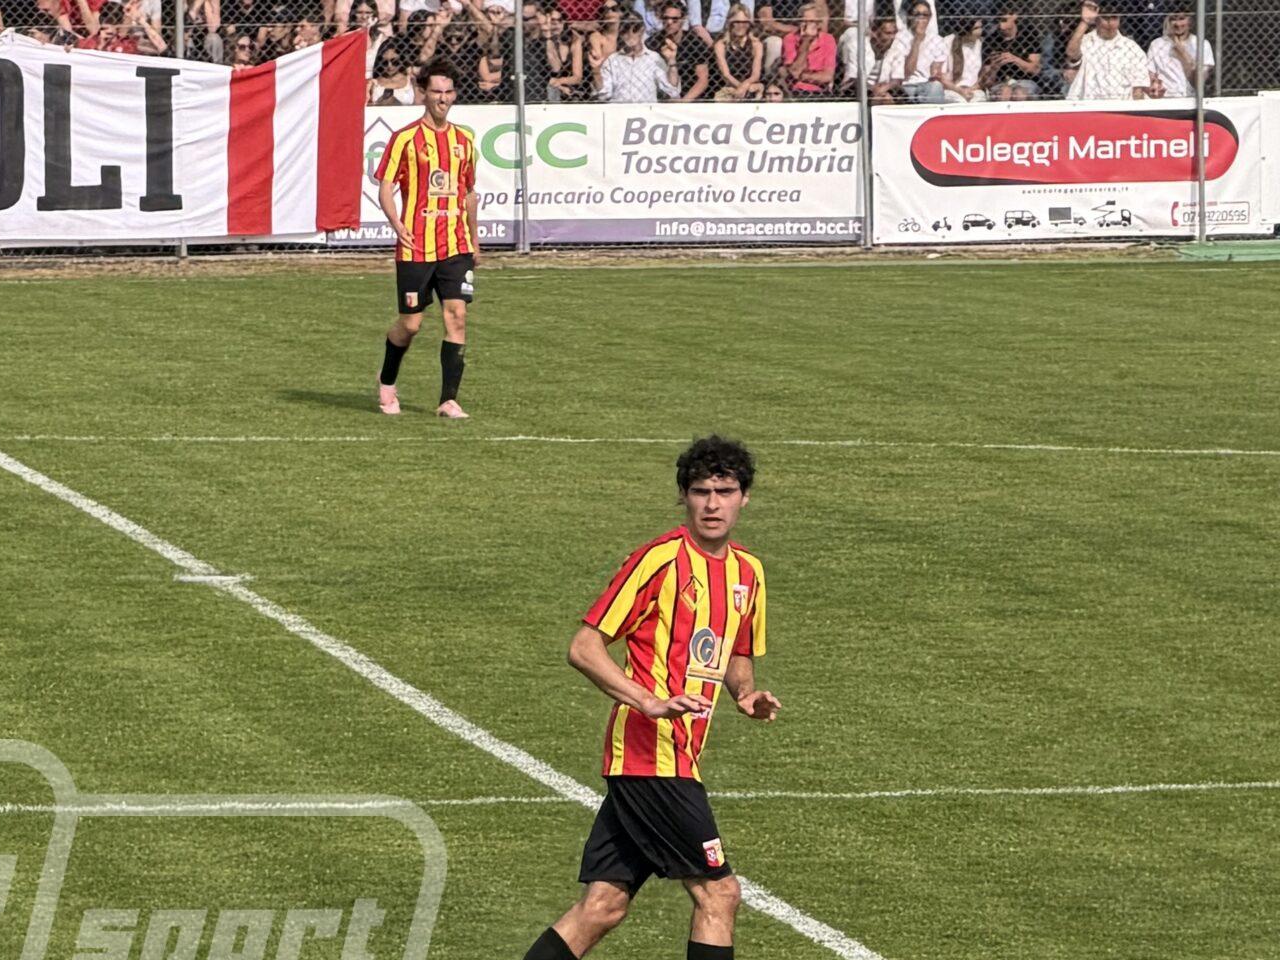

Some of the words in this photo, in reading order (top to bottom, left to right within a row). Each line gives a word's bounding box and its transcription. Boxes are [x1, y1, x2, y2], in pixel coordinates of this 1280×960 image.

[622, 117, 733, 145] Banca
[742, 116, 863, 145] Centro
[461, 122, 588, 169] CC
[940, 135, 1058, 167] Noleggi
[1069, 131, 1210, 161] Martineli
[621, 150, 739, 174] Toscana
[747, 148, 855, 173] Umbria
[514, 186, 604, 205] Bancario
[610, 184, 735, 208] Cooperativo
[740, 186, 801, 203] Iccrea
[655, 220, 862, 236] info@bancacentro.bcc.it
